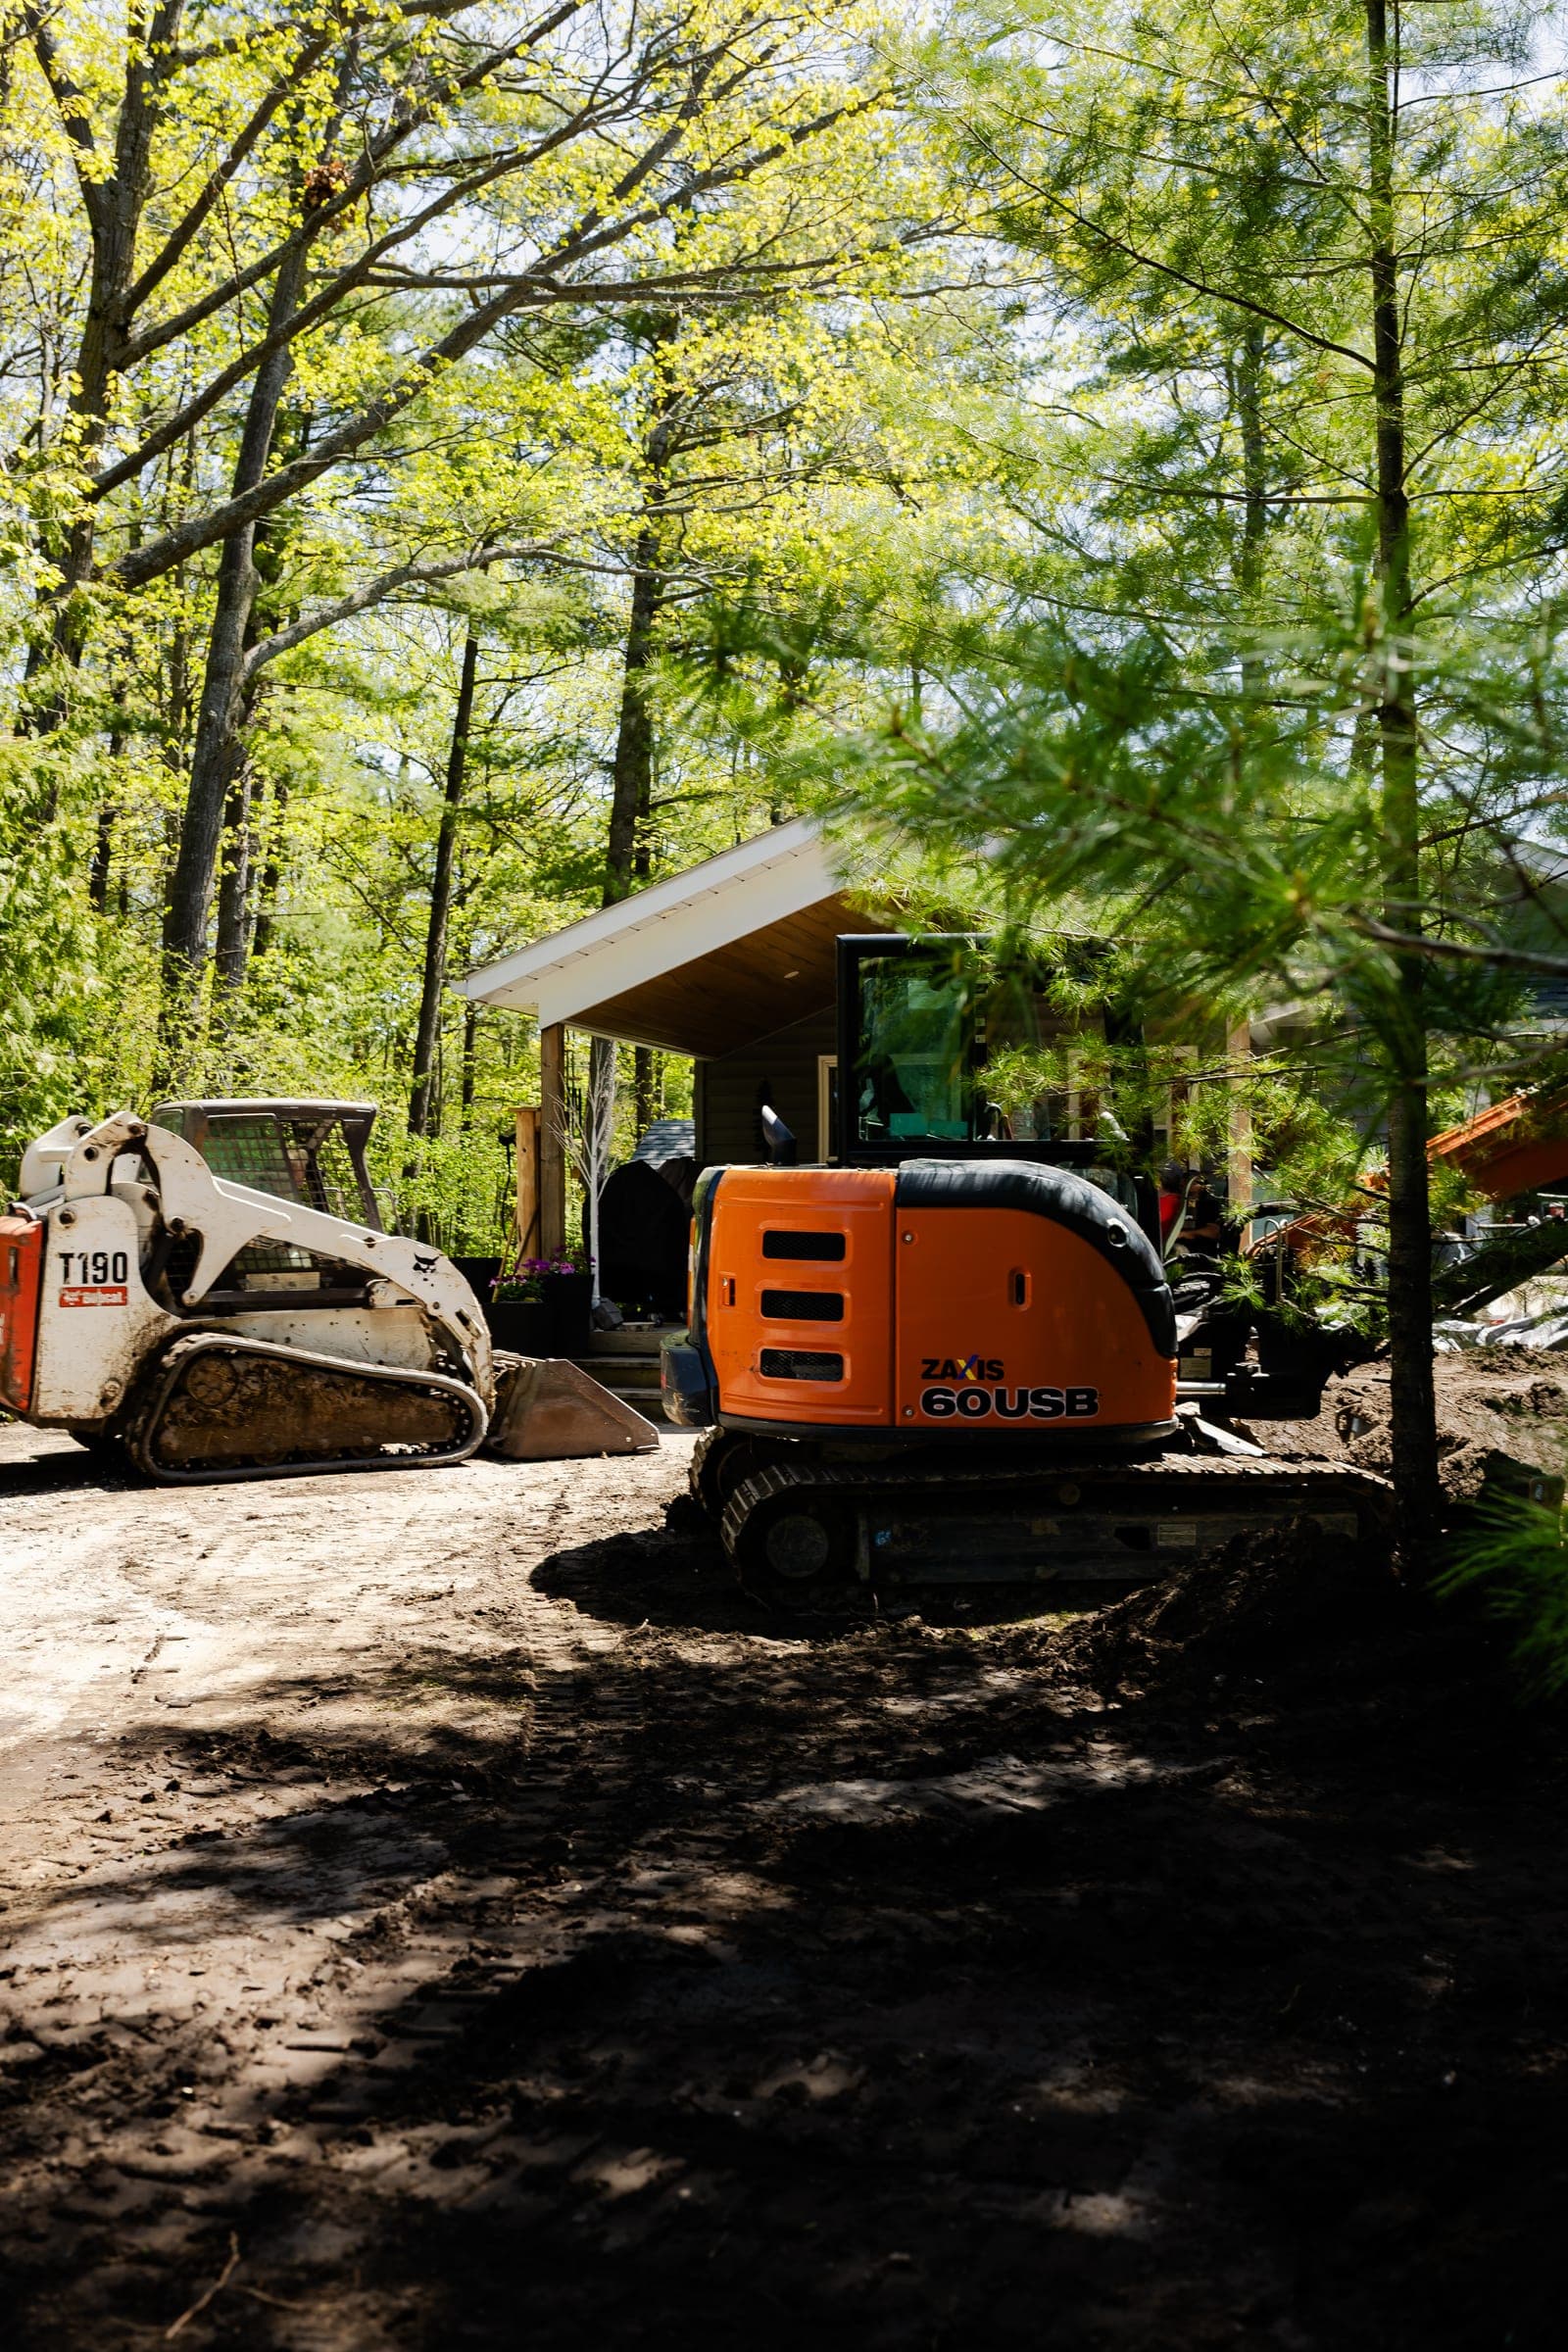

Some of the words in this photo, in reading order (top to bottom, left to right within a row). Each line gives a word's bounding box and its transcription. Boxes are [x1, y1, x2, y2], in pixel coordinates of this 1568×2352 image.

[58, 1251, 127, 1284] T190
[921, 1354, 1004, 1381] ZAXIS
[920, 1387, 1099, 1419] 60USB
